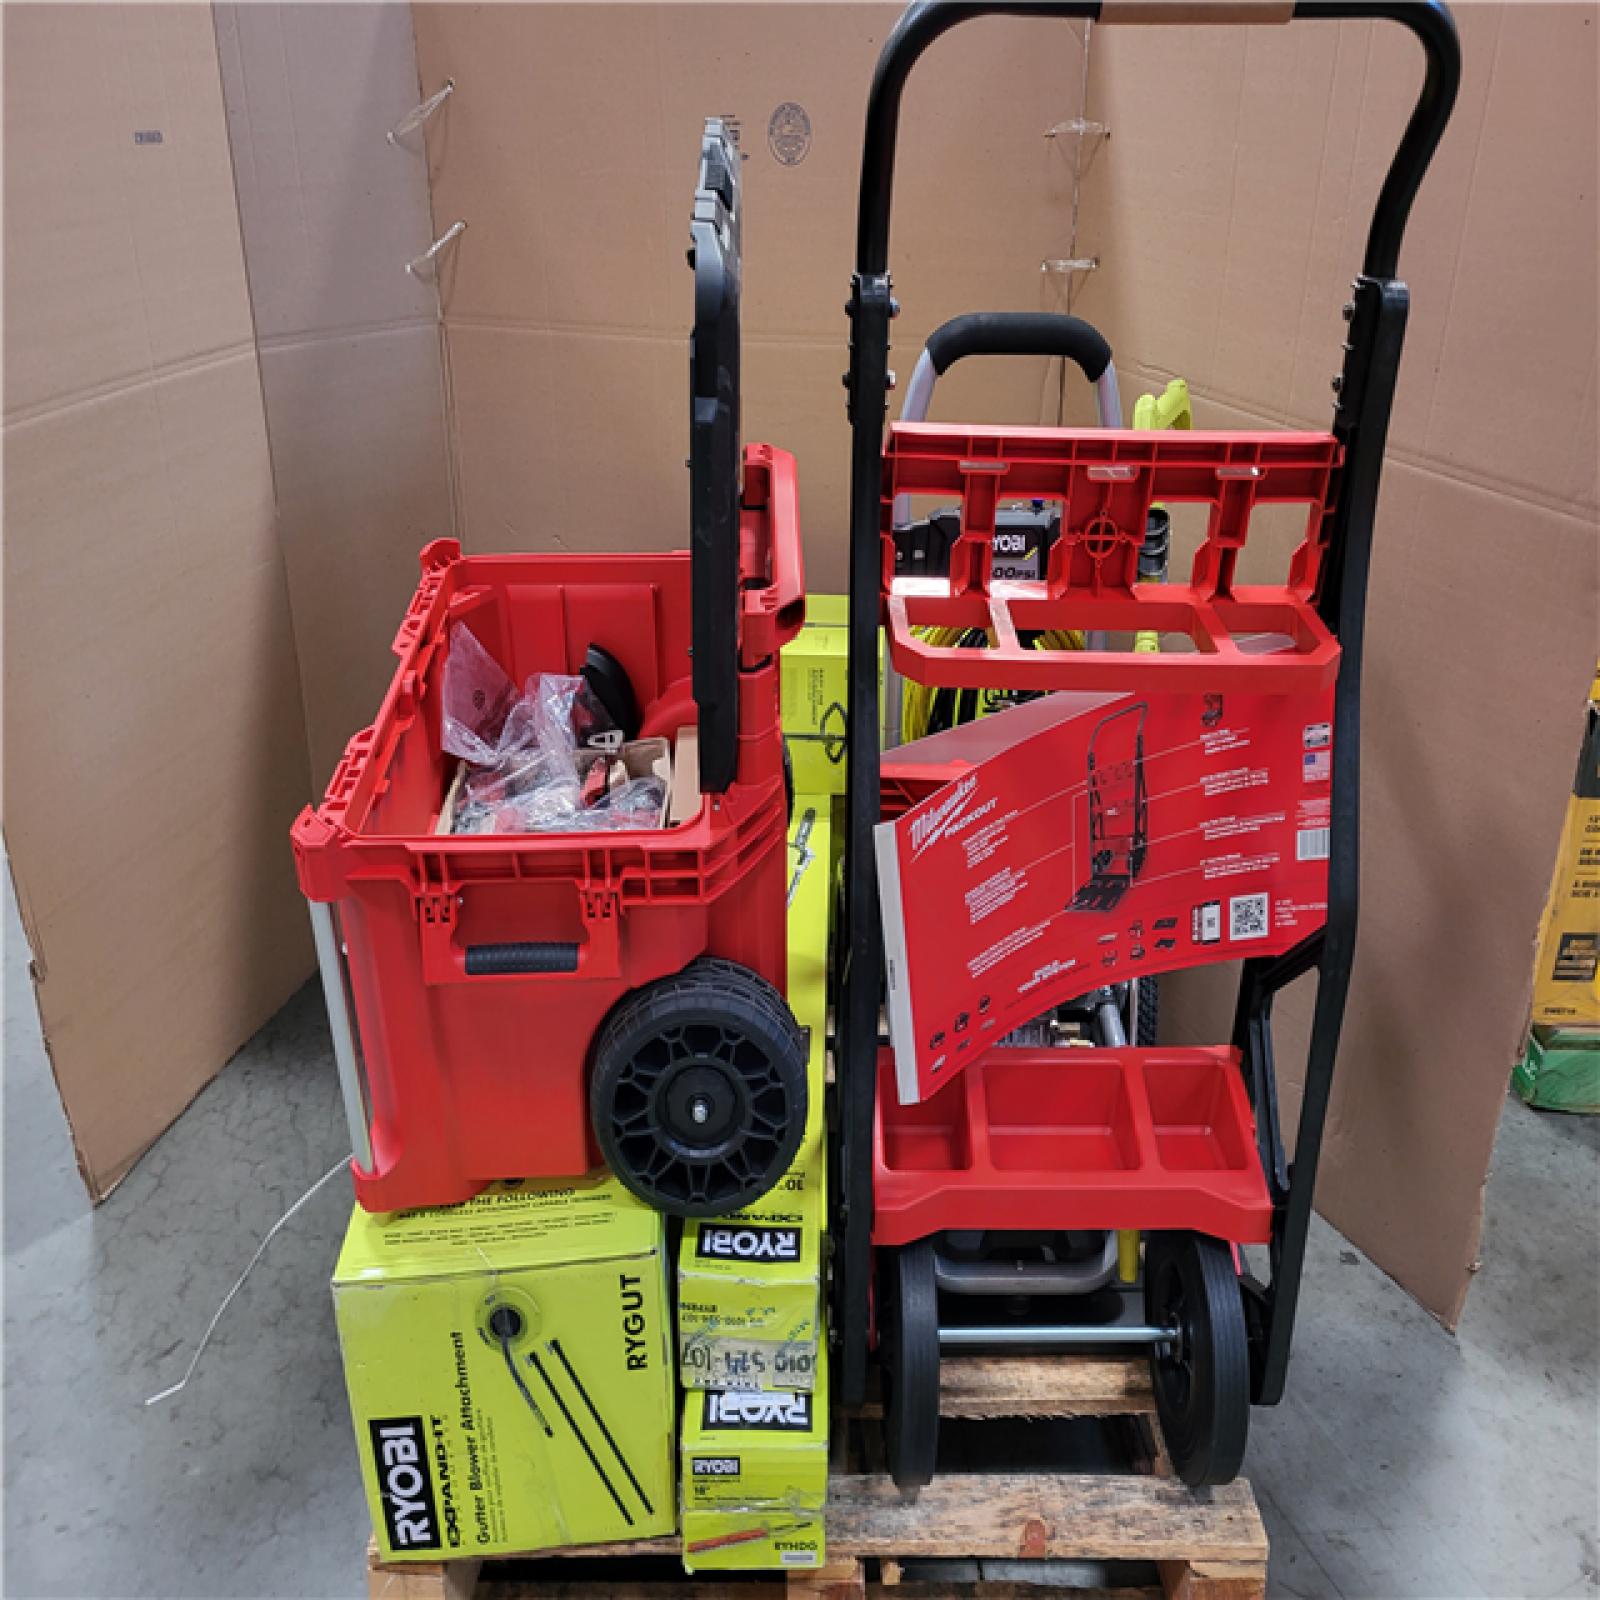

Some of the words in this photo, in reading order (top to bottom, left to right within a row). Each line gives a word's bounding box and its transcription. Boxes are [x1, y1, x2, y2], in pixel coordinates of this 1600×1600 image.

[992, 534, 1026, 551] YOBI
[702, 1230, 797, 1258] RYOBI
[620, 1274, 647, 1370] RYGUT
[454, 1331, 476, 1430] Attachment
[381, 1424, 431, 1544] RYOBI
[463, 1436, 483, 1491] Blower
[473, 1496, 490, 1543] Gutter
